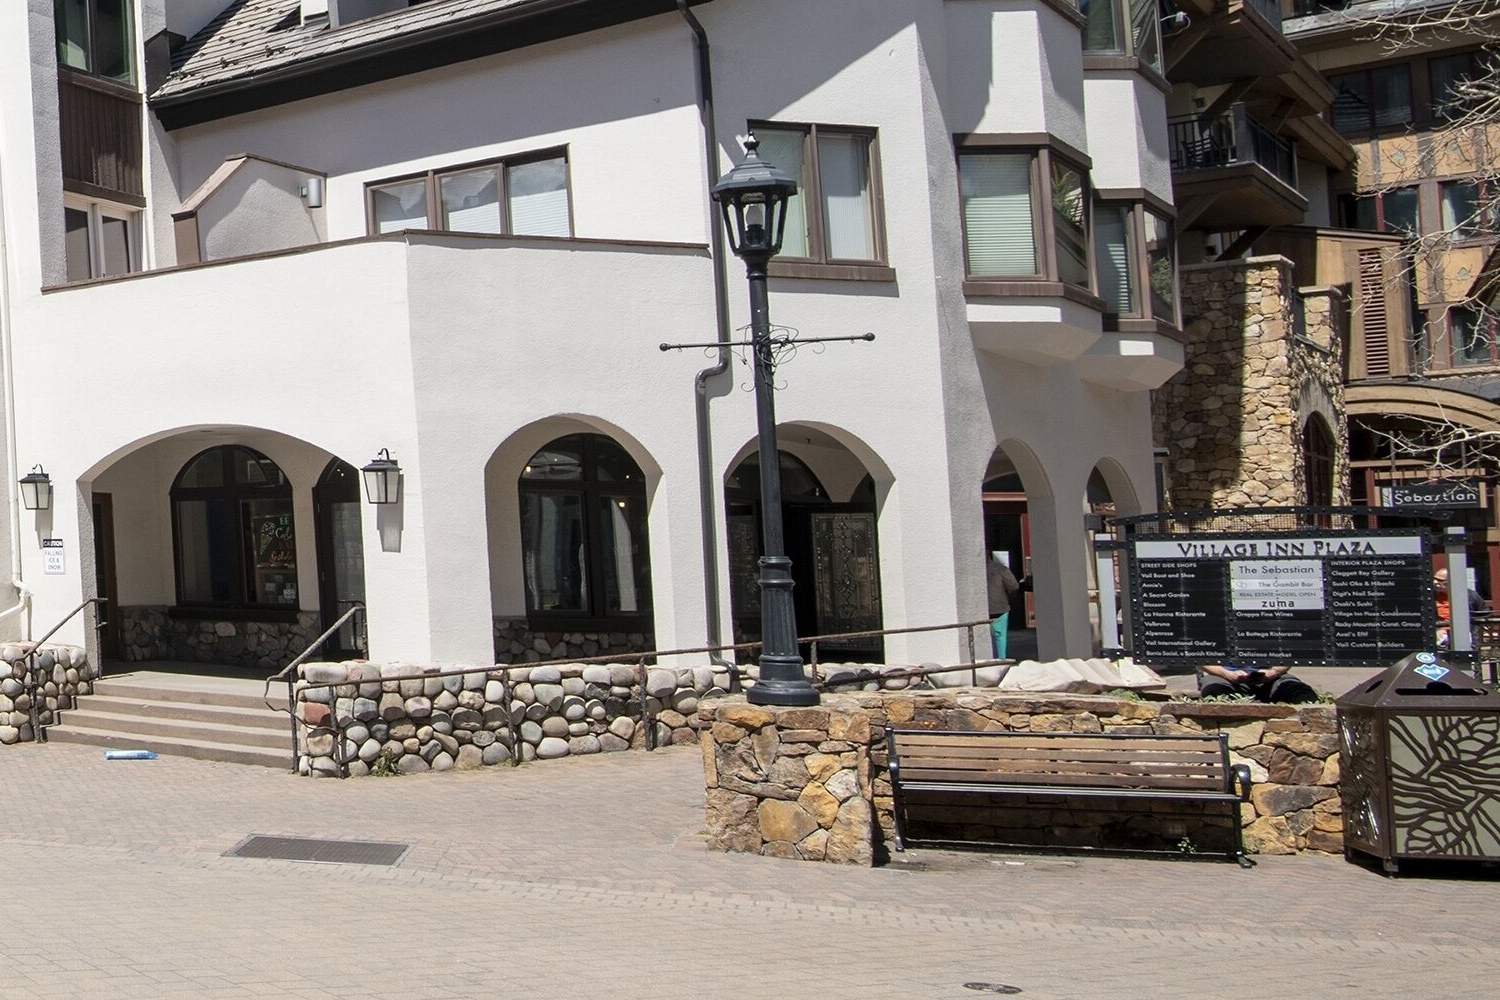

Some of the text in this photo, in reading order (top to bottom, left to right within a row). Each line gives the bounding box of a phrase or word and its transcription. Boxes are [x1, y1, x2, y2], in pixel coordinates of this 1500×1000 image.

[1394, 492, 1477, 504] Sebastian
[1178, 541, 1376, 557] VILLAGE INN PLAZA
[1239, 566, 1314, 574] The Sebastian
